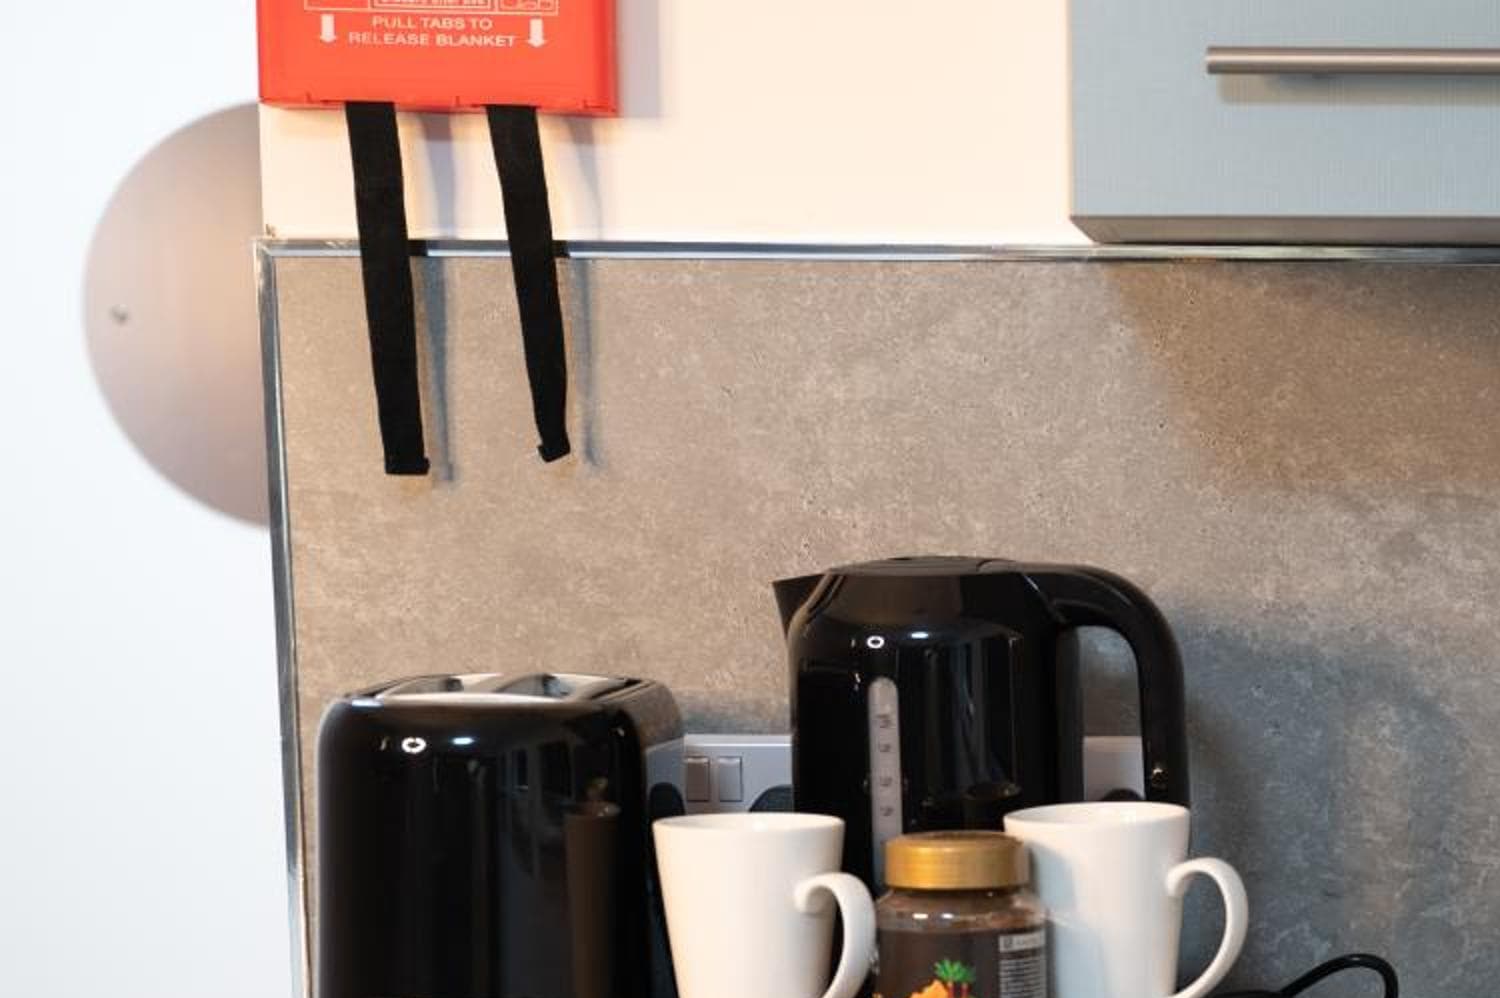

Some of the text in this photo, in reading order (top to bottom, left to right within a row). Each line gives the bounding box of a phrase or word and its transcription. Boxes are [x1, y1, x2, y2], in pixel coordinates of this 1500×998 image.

[371, 15, 493, 30] PULL TABS TO
[349, 31, 516, 47] RELEASE BLANKET
